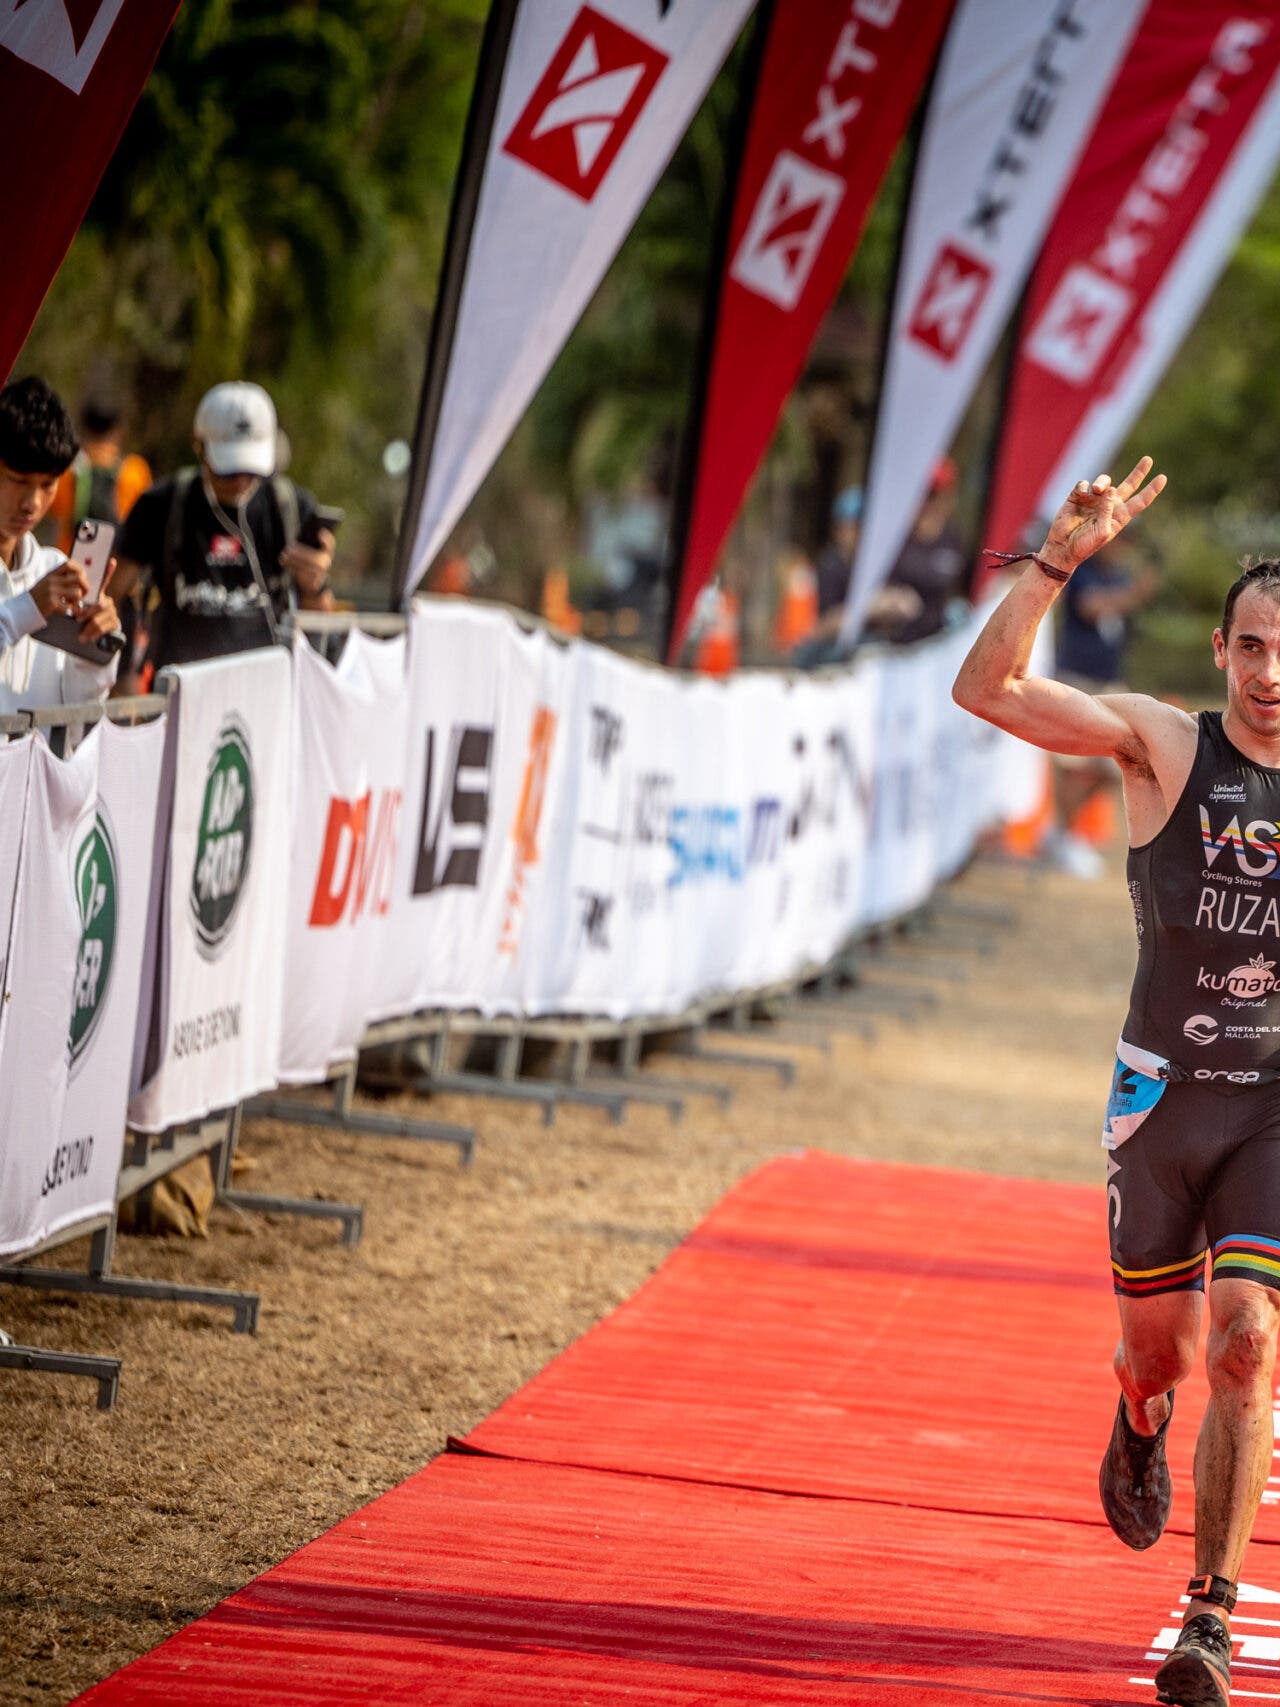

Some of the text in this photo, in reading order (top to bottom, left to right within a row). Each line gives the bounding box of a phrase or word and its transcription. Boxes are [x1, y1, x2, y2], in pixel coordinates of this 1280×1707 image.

[1201, 869, 1263, 888] Cycling Stores
[1220, 997, 1268, 1010] Original
